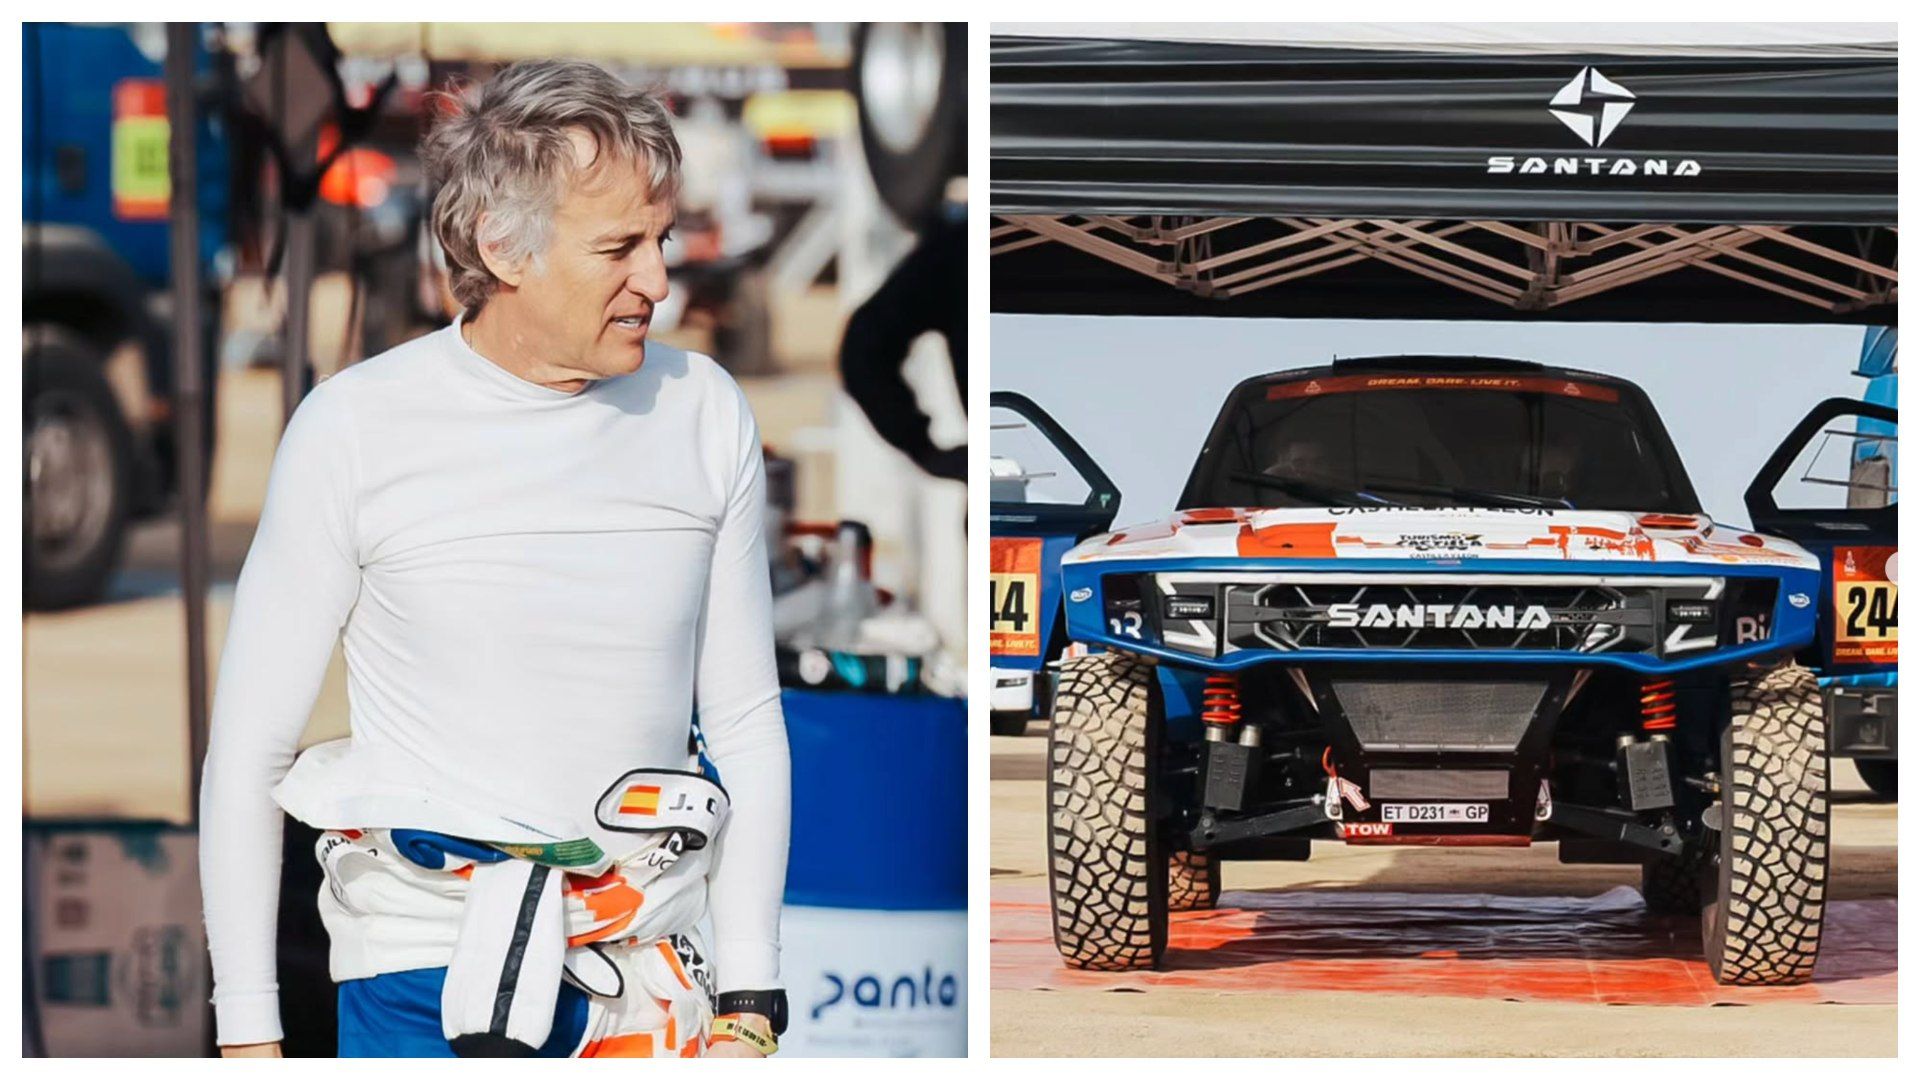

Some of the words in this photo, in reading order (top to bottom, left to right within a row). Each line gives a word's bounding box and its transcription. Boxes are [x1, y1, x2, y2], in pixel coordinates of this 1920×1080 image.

[1487, 157, 1702, 177] SANTANA
[1327, 603, 1552, 629] SANTANA
[669, 793, 694, 811] J.
[1384, 806, 1403, 820] ET
[1409, 806, 1445, 820] D231
[1465, 806, 1488, 820] GP
[1347, 824, 1390, 836] TOW
